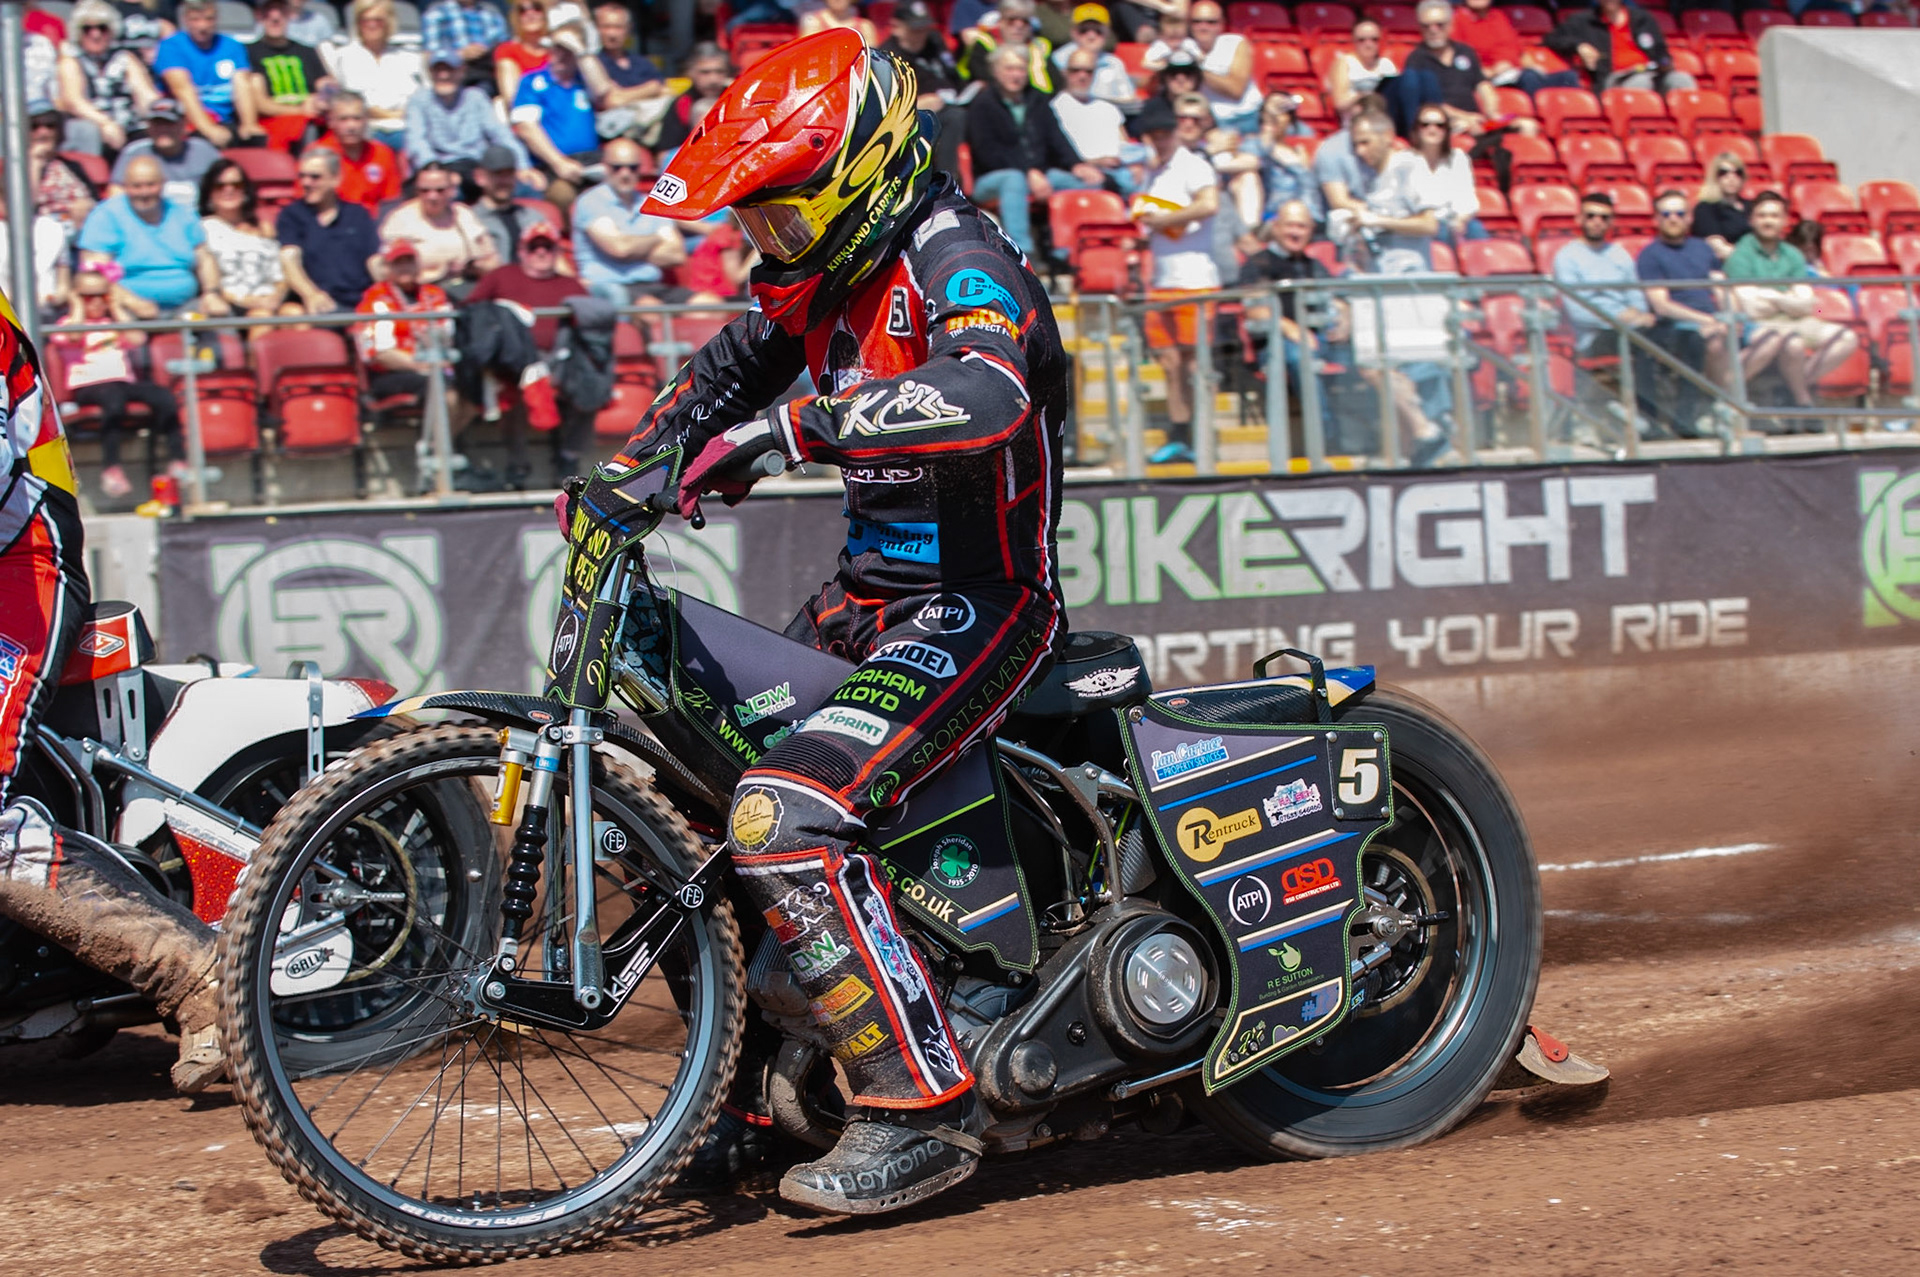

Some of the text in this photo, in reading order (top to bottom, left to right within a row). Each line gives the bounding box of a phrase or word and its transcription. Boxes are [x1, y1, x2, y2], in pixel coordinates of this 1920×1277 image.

[827, 221, 871, 272] KIRKLAND
[868, 176, 902, 225] CARPETS
[892, 295, 904, 328] 5
[1056, 474, 1657, 607] BIKERIGHT
[925, 606, 964, 621] ATPI
[556, 634, 574, 653] ATPI
[1388, 608, 1580, 667] YOUR
[1610, 598, 1748, 653] RIDE
[875, 644, 949, 675] SHOEI
[734, 682, 789, 719] NOW
[834, 686, 900, 712] LLOYD
[912, 628, 1044, 772] SPORTS EVENTS
[824, 710, 883, 738] SPRINT
[875, 778, 895, 802] ATPI
[1338, 748, 1380, 804] 5
[941, 837, 973, 851] Sheridan
[1185, 815, 1257, 850] Rentruck
[1236, 889, 1264, 912] ATPI
[1295, 886, 1330, 901] CONSTRUCTION
[1280, 967, 1314, 983] SUTTON
